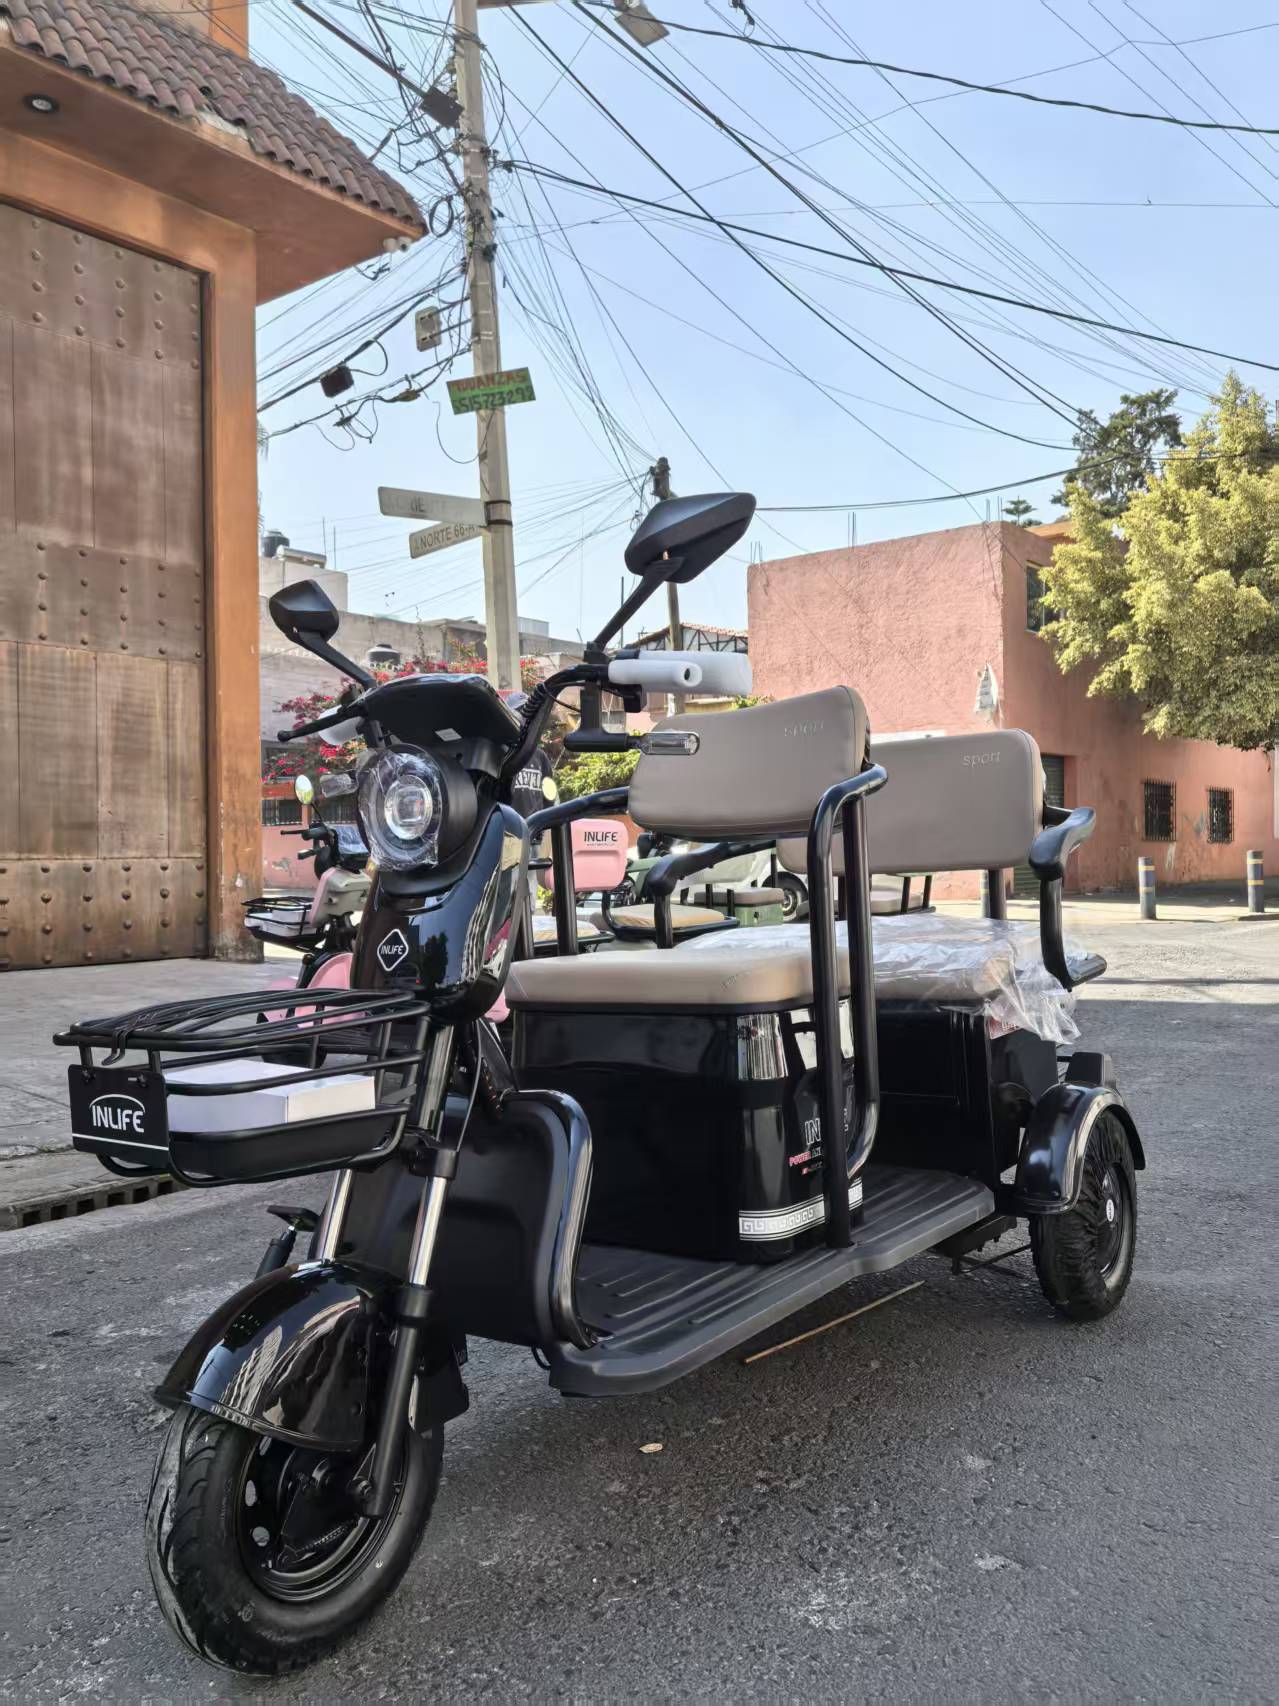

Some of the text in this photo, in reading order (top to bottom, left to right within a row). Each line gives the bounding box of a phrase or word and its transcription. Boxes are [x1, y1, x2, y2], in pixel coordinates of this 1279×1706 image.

[420, 525, 452, 550] NORTE
[584, 831, 619, 842] INLIFE
[380, 944, 404, 955] INLIFE
[91, 1105, 145, 1133] INLIFE
